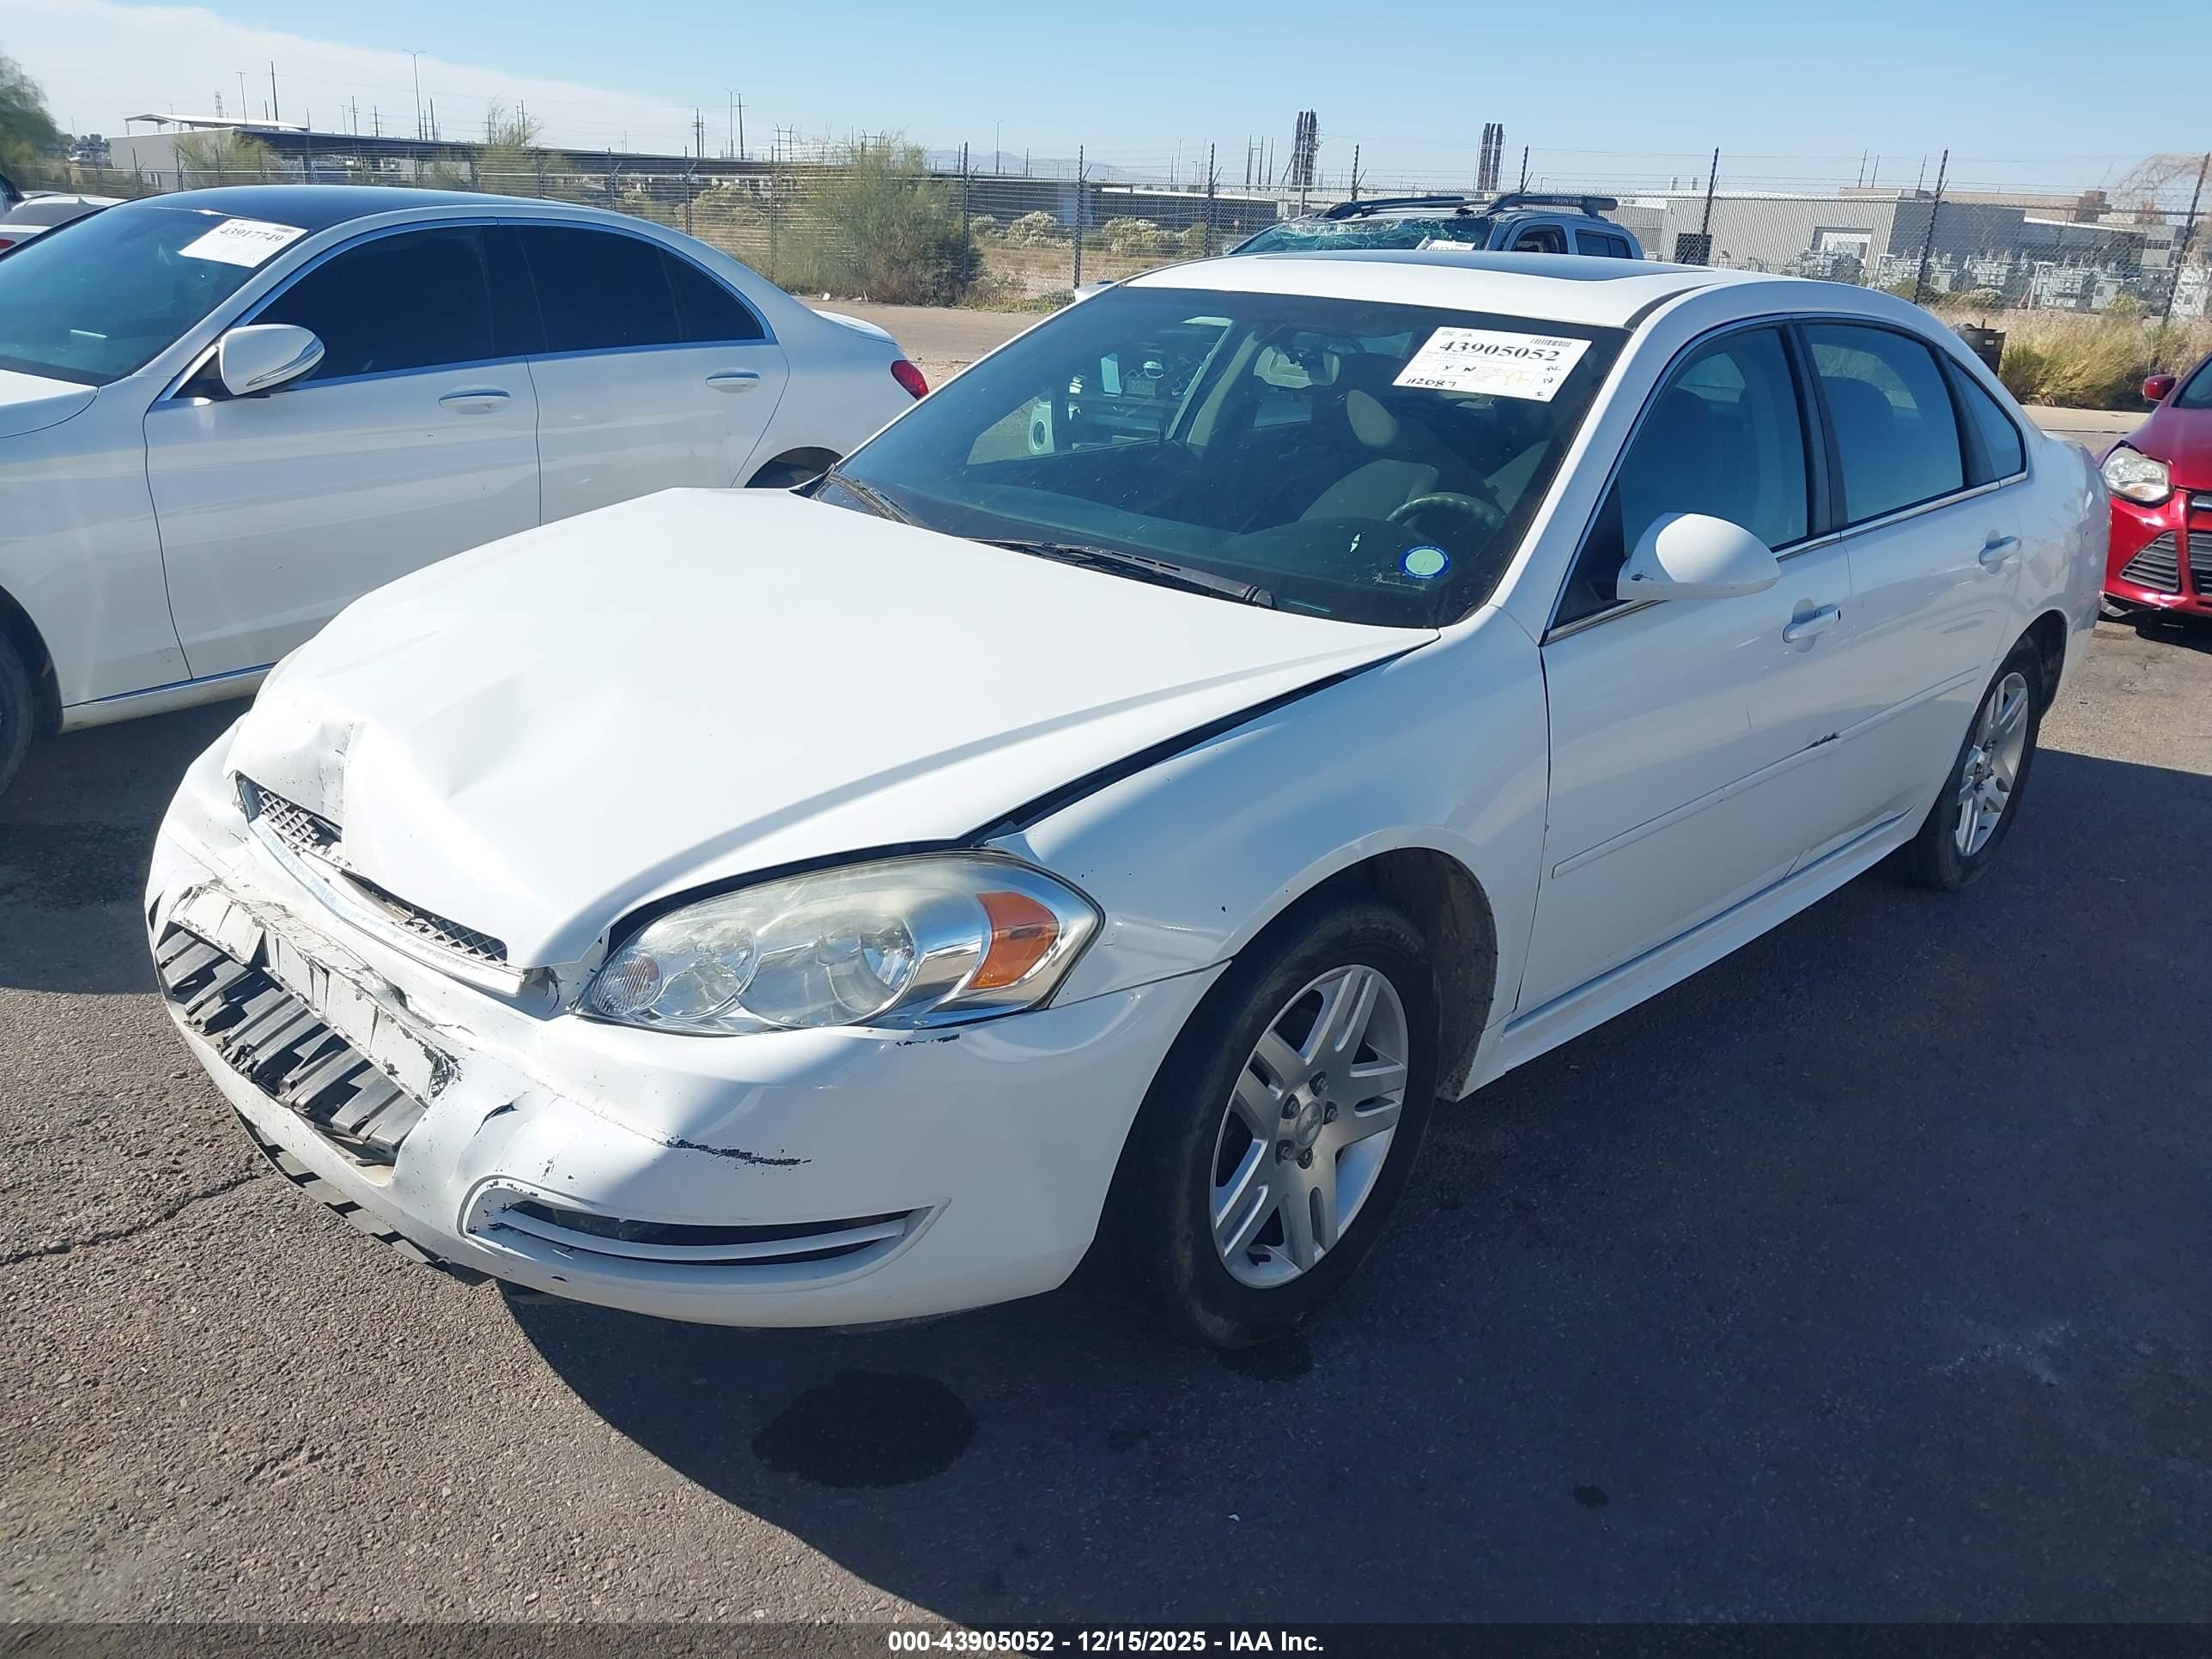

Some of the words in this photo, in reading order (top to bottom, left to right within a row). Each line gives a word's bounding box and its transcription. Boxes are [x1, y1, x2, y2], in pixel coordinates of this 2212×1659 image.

[1552, 197, 1582, 205] FRONTIER
[219, 228, 285, 242] 43917749
[1439, 340, 1561, 362] 43905052
